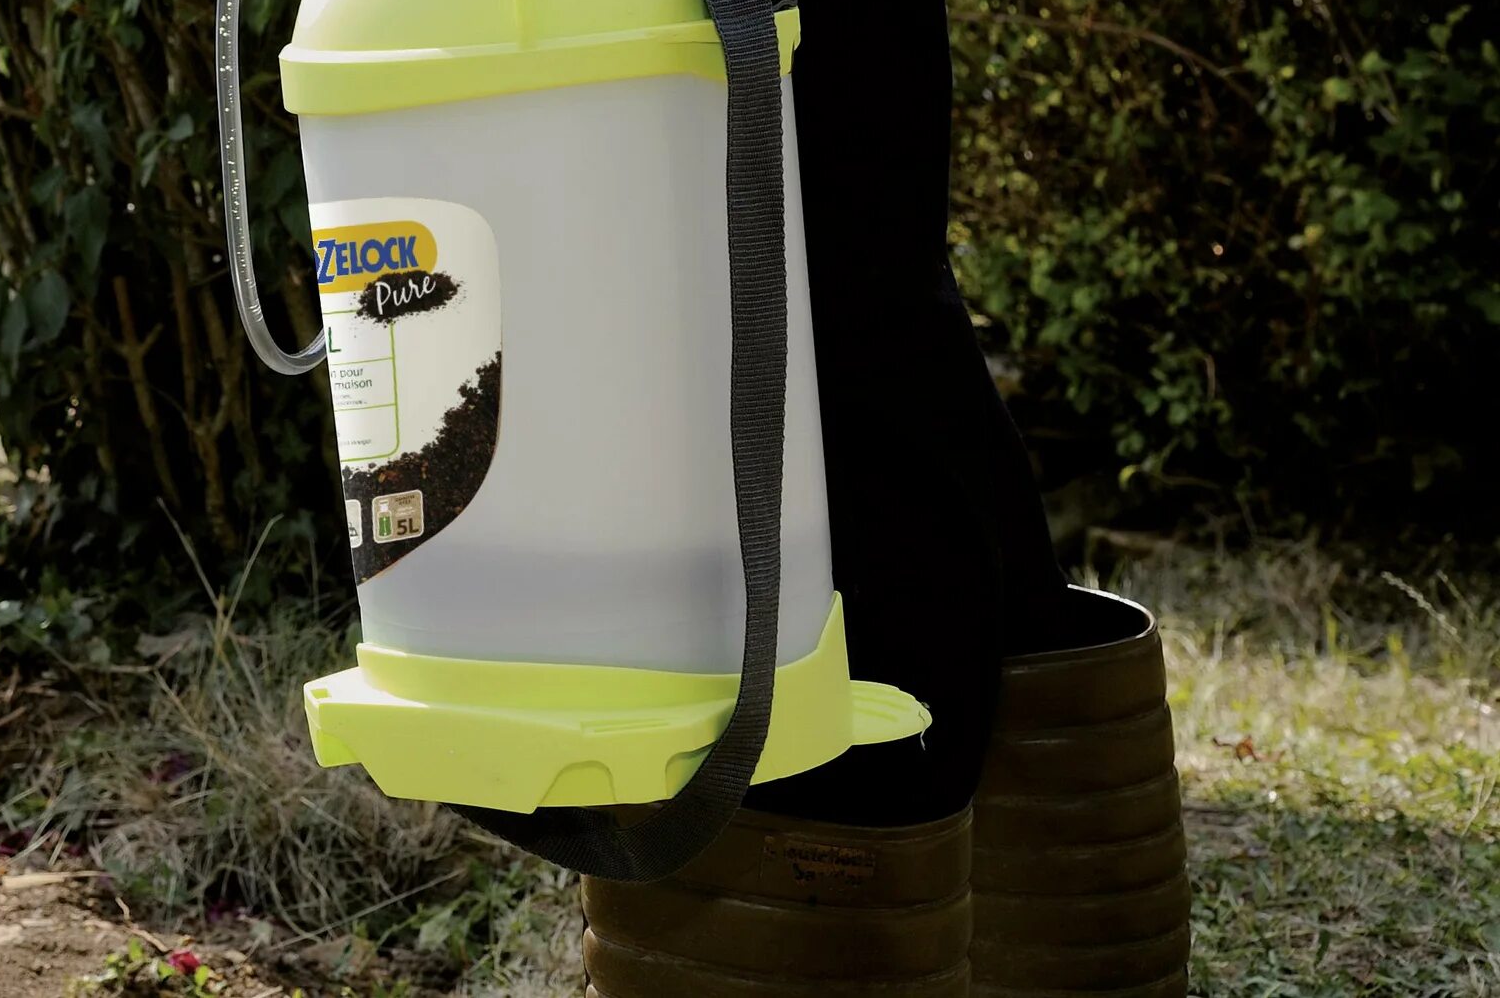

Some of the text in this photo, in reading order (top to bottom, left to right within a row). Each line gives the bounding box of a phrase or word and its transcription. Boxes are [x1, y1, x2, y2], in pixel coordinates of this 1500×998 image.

[374, 276, 436, 315] Pure
[340, 368, 364, 380] pour
[334, 379, 373, 391] maison
[397, 518, 420, 536] 5L
